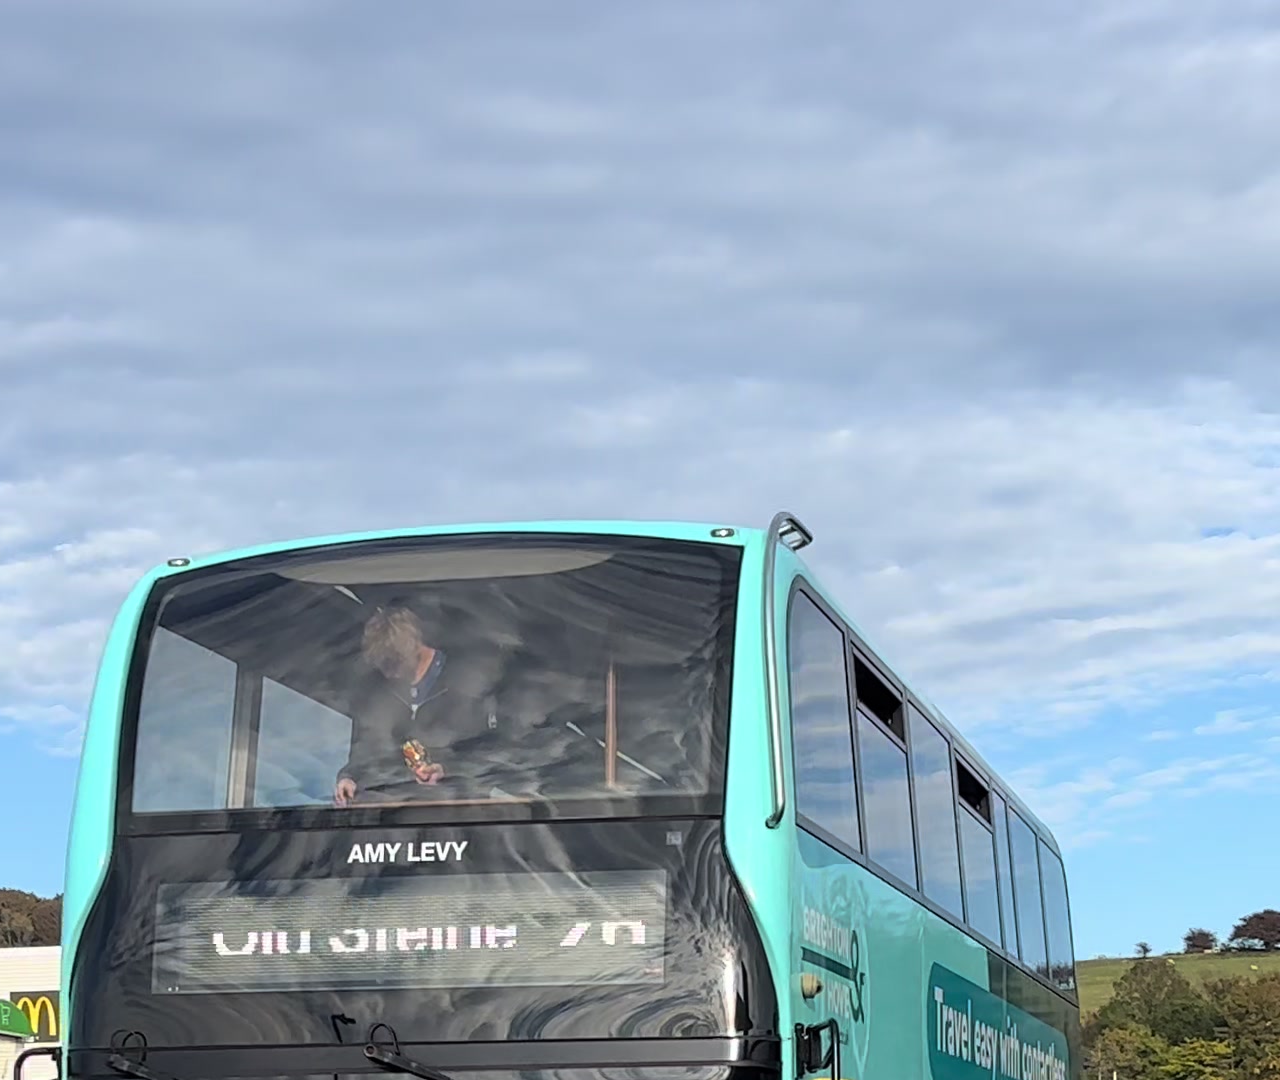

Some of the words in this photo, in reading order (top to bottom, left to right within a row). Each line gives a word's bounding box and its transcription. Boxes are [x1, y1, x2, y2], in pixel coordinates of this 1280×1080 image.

[347, 843, 402, 864] AMY
[407, 841, 469, 862] LEVY
[933, 985, 972, 1063] Travel
[999, 1014, 1021, 1080] with
